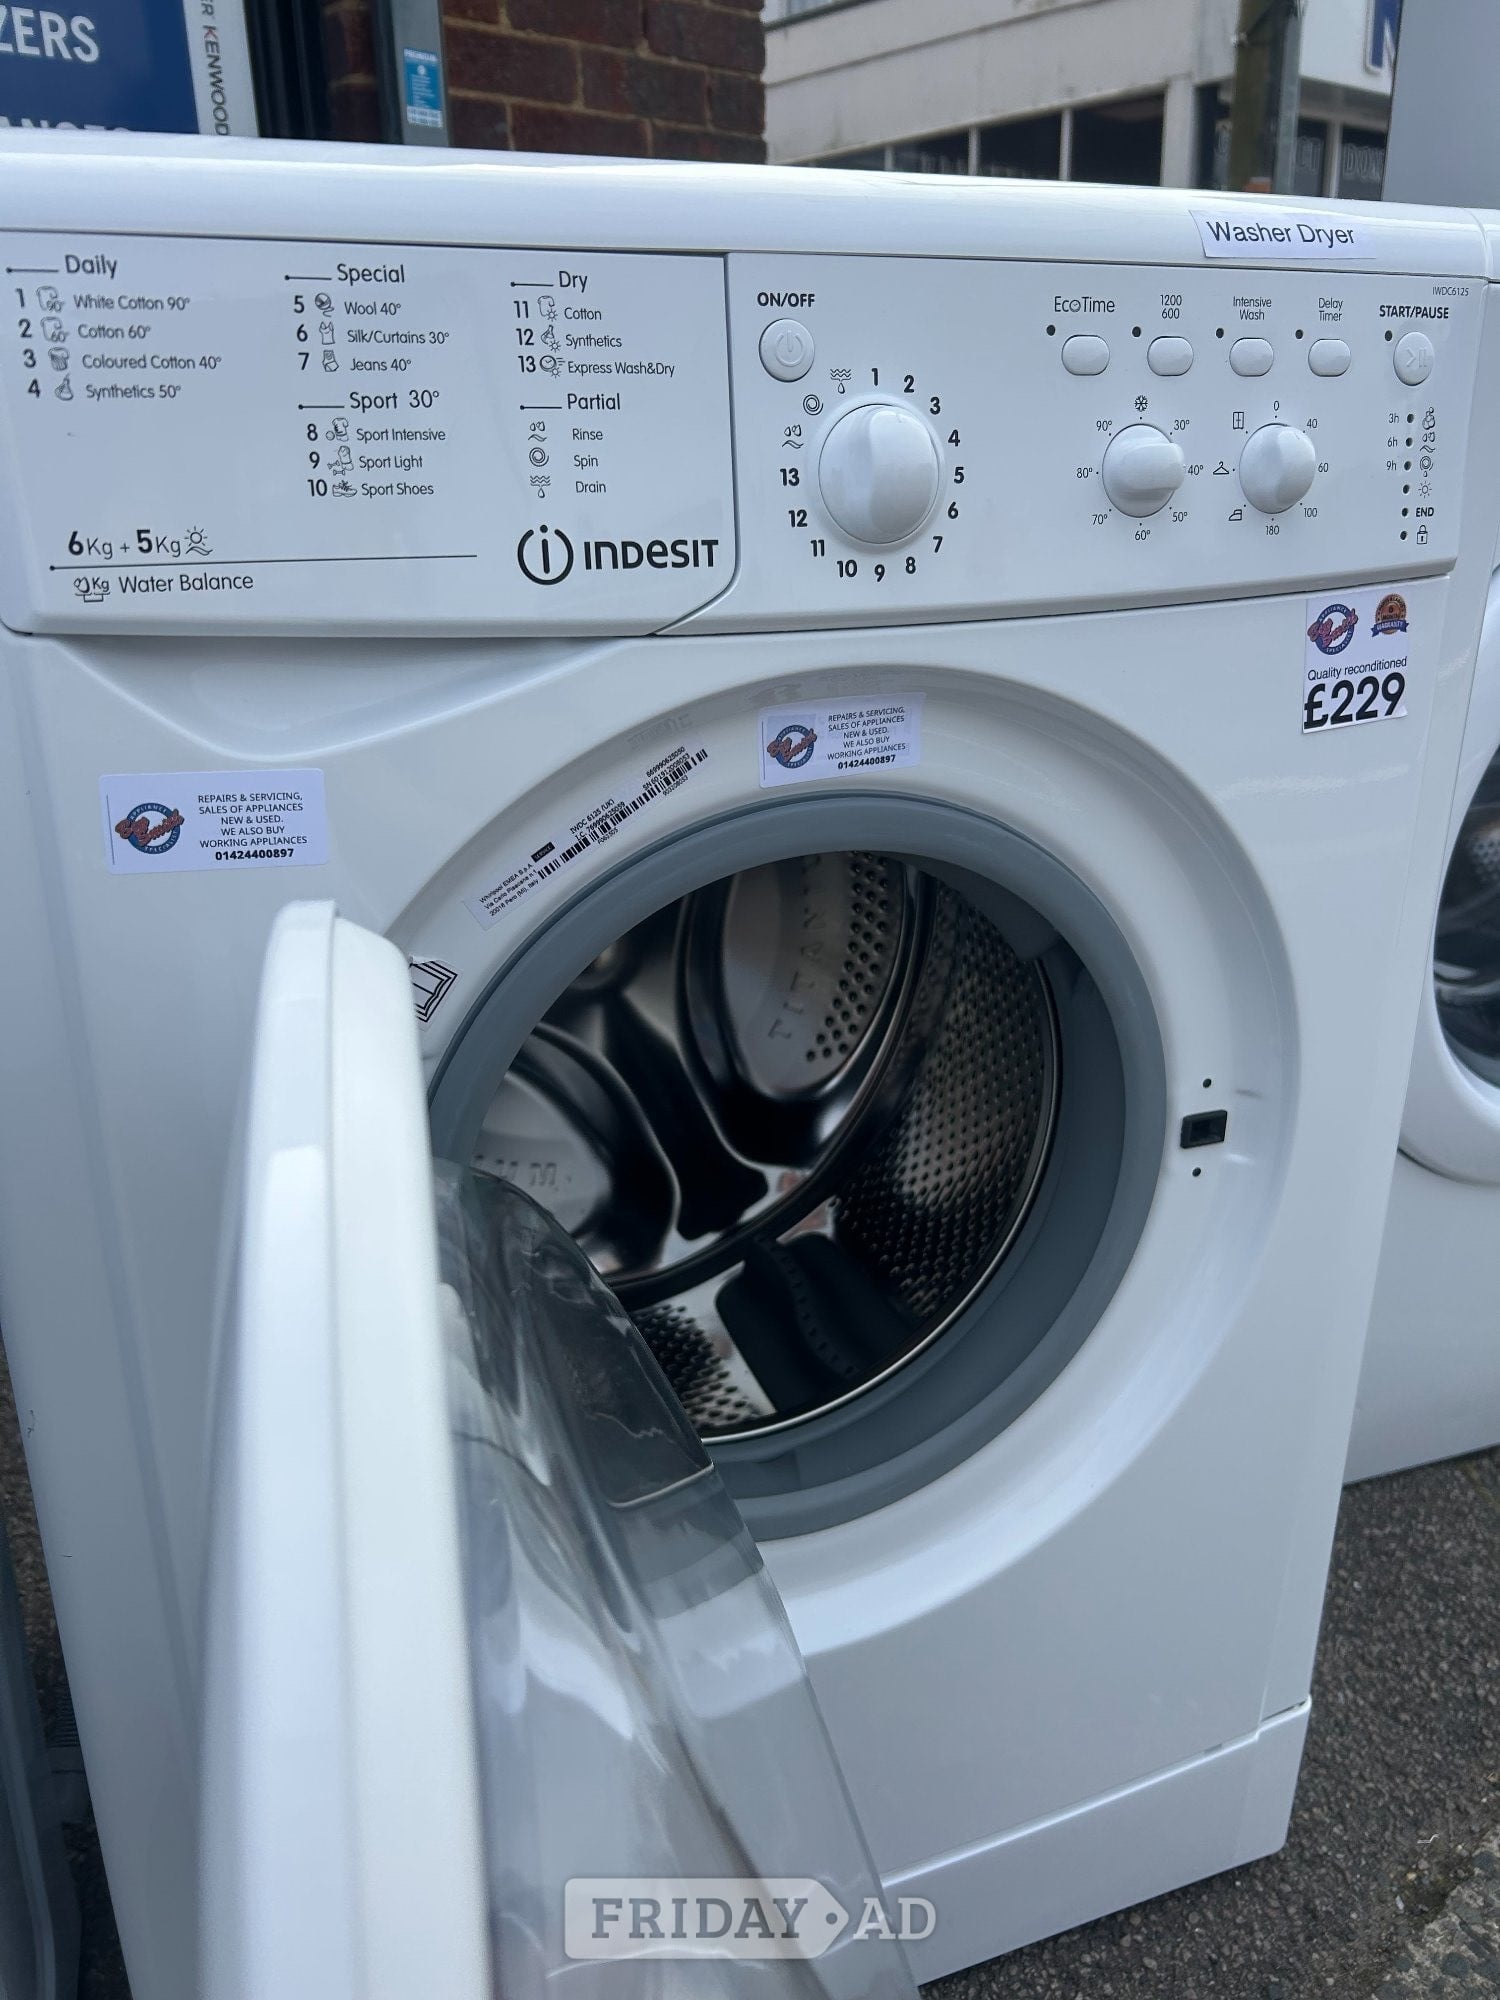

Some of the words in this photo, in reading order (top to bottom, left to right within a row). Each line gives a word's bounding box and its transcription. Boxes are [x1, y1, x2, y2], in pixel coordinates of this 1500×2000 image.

[202, 0, 214, 16] R
[203, 25, 229, 136] KENWOOD
[1206, 221, 1291, 243] Washer
[1296, 224, 1354, 248] Dryer
[65, 254, 117, 279] Daily
[337, 263, 405, 286] Special
[559, 271, 588, 293] Dry
[16, 288, 25, 308] 1
[73, 294, 114, 310] White
[118, 296, 164, 310] Cotton
[757, 292, 815, 307] ON/OFF
[1432, 286, 1469, 297] IWDC6125
[294, 295, 305, 313] 5
[344, 302, 377, 315] Wool
[1054, 296, 1115, 313] EcoTime
[1160, 295, 1182, 306] 1200
[1233, 296, 1272, 308] Intensive
[1319, 298, 1343, 311] Delay
[514, 301, 529, 318] 11
[564, 307, 602, 320] Cotton
[1161, 308, 1180, 319] 600
[1239, 309, 1265, 321] Wash
[1319, 310, 1342, 322] Timer
[1379, 304, 1449, 319] START/PAUSE
[18, 318, 32, 338] 2
[78, 324, 124, 338] Cotton
[297, 324, 308, 342] 6
[347, 330, 425, 344] Silk/Curtains
[516, 328, 534, 345] 12
[566, 334, 622, 349] Synthetics
[23, 349, 36, 368] 3
[82, 354, 147, 369] Coloured
[150, 355, 195, 369] Cotton
[298, 352, 309, 370] 7
[350, 358, 387, 371] Jeans
[518, 355, 536, 373] 13
[568, 361, 612, 376] Express
[615, 361, 675, 377] Wash&Dry
[871, 368, 879, 386] 1
[904, 375, 915, 393] 2
[28, 378, 40, 397] 4
[86, 384, 154, 401] Synthetics
[350, 392, 397, 413] Sport
[567, 393, 621, 410] Partial
[930, 397, 941, 414] 3
[1273, 401, 1280, 411] 0
[1306, 419, 1318, 429] 40
[1388, 413, 1400, 423] 3h
[307, 423, 318, 441] 8
[357, 428, 389, 443] Sport
[392, 428, 446, 440] Intensive
[572, 428, 603, 440] Rinse
[948, 430, 960, 447] 4
[1387, 437, 1398, 447] 6h
[309, 451, 320, 469] 9
[359, 456, 390, 471] Sport
[394, 455, 423, 471] Light
[574, 455, 598, 470] Spin
[1318, 463, 1329, 473] 60
[1386, 460, 1397, 471] 9h
[780, 468, 800, 486] 13
[954, 467, 964, 484] 5
[307, 479, 327, 496] 10
[361, 483, 393, 498] Sport
[397, 483, 434, 495] Shoes
[575, 481, 606, 493] Drain
[789, 509, 808, 527] 12
[948, 501, 959, 519] 6
[1303, 507, 1318, 518] 100
[1415, 507, 1434, 517] END
[1265, 525, 1280, 536] 180
[811, 539, 825, 557] 11
[933, 536, 943, 553] 7
[584, 539, 719, 570] INDESIT
[837, 560, 858, 578] 10
[874, 564, 885, 582] 9
[906, 556, 917, 574] 8
[119, 576, 174, 593] Water
[179, 572, 254, 592] Balance
[1307, 667, 1342, 681] Quality
[1344, 656, 1408, 675] reconditioned
[1303, 672, 1406, 730] £229
[828, 711, 857, 722] REPAIRS
[859, 710, 864, 718] &
[828, 721, 849, 732] SALES
[851, 720, 861, 729] OF
[862, 715, 905, 727] APPLIANCES
[843, 731, 860, 739] NEW
[843, 740, 854, 748] WE
[856, 738, 874, 747] ALSO
[876, 736, 890, 744] BUY
[828, 749, 863, 760] WORKING
[864, 743, 906, 755] APPLIANCES
[838, 754, 896, 770] 01424400897
[198, 794, 237, 803] REPAIRS
[240, 793, 247, 802] &
[250, 792, 303, 802] SERVICING,
[198, 805, 227, 814] SALES
[230, 804, 241, 814] OF
[243, 803, 303, 813] APPLIANCES
[221, 816, 244, 825] NEW
[246, 815, 253, 824] &
[256, 814, 284, 824] USED.
[221, 827, 236, 836] WE
[239, 826, 263, 835] ALSO
[266, 825, 285, 834] BUY
[200, 838, 247, 848] WORKING
[250, 836, 308, 846] APPLIANCES
[215, 848, 294, 861] 01424400897
